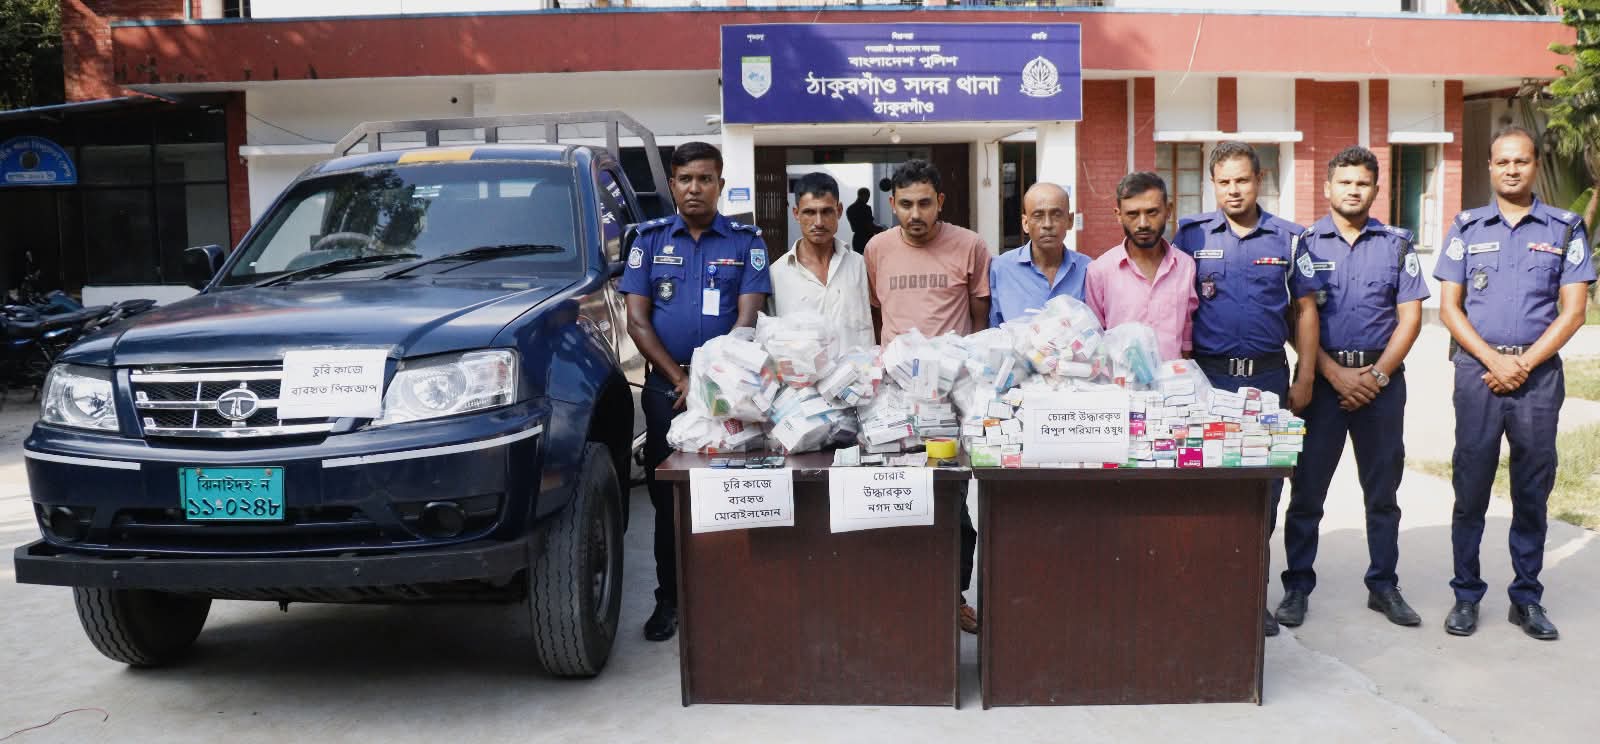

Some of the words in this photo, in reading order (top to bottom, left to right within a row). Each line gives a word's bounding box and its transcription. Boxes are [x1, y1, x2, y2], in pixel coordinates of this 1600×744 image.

[847, 56, 916, 68] বাংলাদেশ
[919, 54, 959, 69] পুলিশ
[805, 72, 897, 101] ঠাকুরগাঁও
[902, 76, 951, 95] সদর
[956, 75, 1001, 95] থানা
[873, 97, 935, 117] ঠাকুরগাঁও
[312, 364, 331, 377] চুরি
[334, 365, 364, 375] কাজে
[331, 383, 378, 394] পিকআপ
[1047, 411, 1077, 421] চোরাই
[1040, 424, 1066, 437] বিপুল
[873, 471, 906, 481] চোরাই
[723, 477, 740, 493] চুরি
[742, 479, 772, 489] কাজে
[863, 485, 913, 499] উদ্ধারকৃত
[187, 498, 281, 516] ১১-০২৪৮
[728, 495, 765, 505] ব্যবহৃত
[867, 503, 891, 513] নগদ
[893, 499, 914, 512] অর্থ
